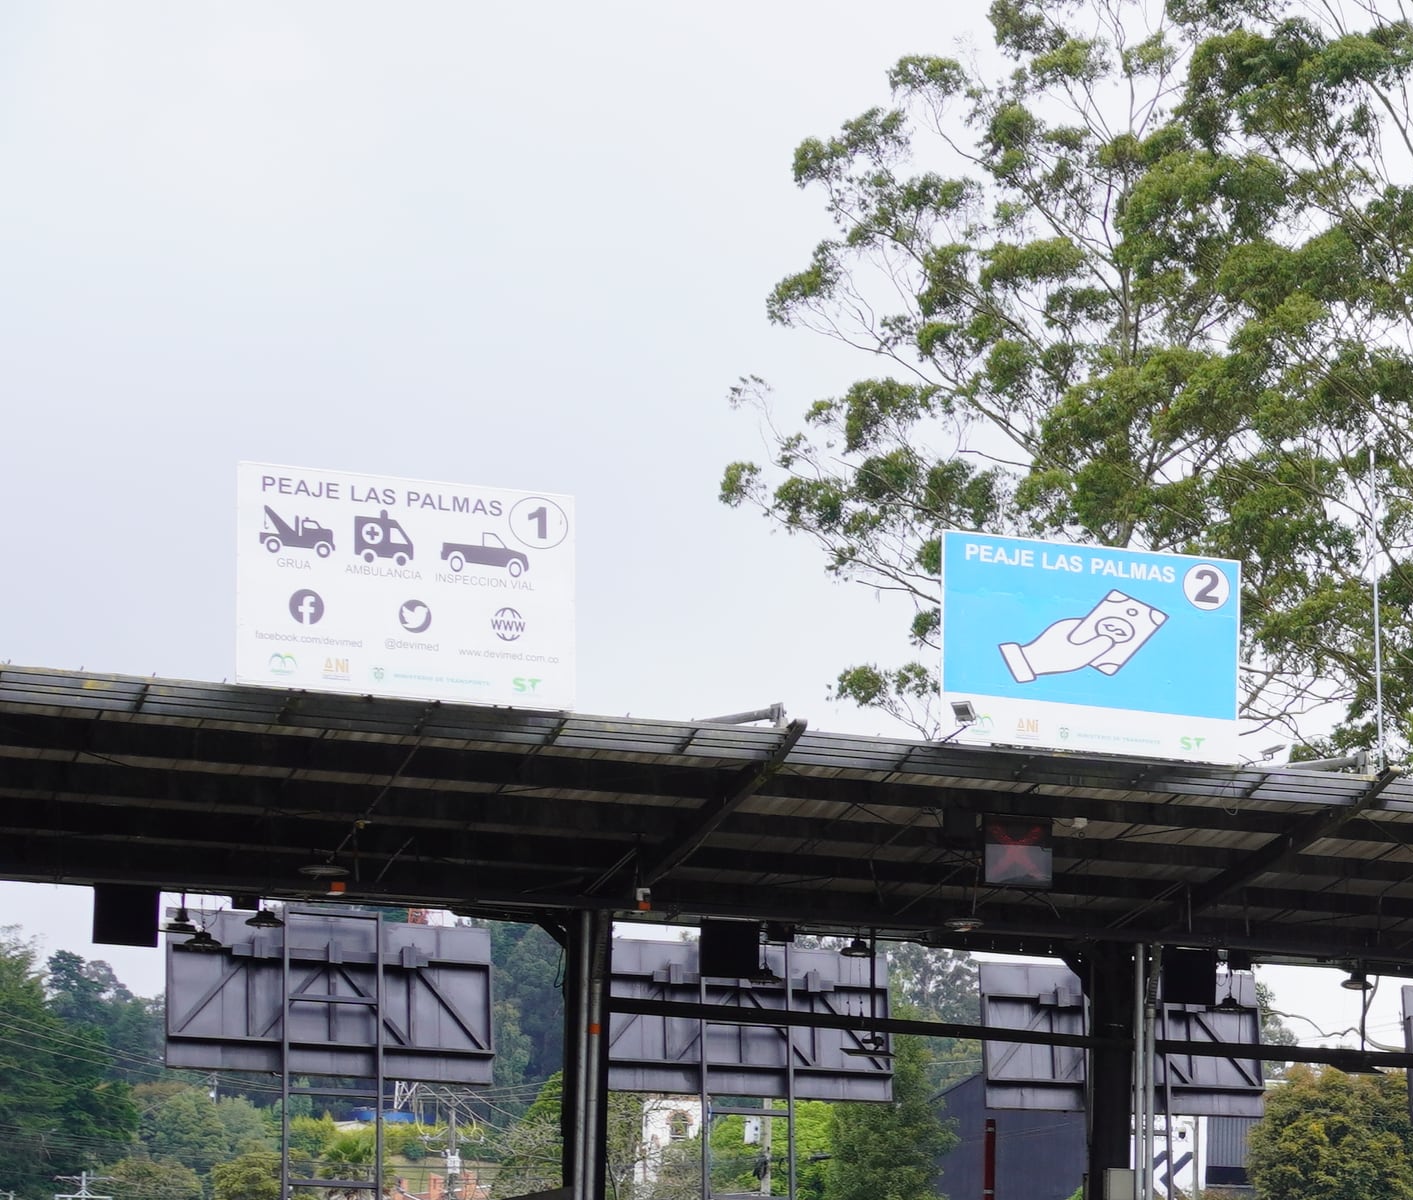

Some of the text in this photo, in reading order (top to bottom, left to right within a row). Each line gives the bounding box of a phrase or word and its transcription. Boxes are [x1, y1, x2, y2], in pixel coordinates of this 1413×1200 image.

[261, 476, 503, 517] PEAJE LAS PALMAS
[527, 506, 548, 540] 1
[276, 557, 312, 570] GRUA
[965, 543, 1176, 583] PEAJE LAS PALMAS
[345, 564, 422, 581] AMBULANCIA
[435, 573, 535, 591] INSPECCION VIAL
[1194, 569, 1219, 604] 2
[255, 630, 363, 648] facebook.com/devimed
[384, 638, 439, 653] @devimed
